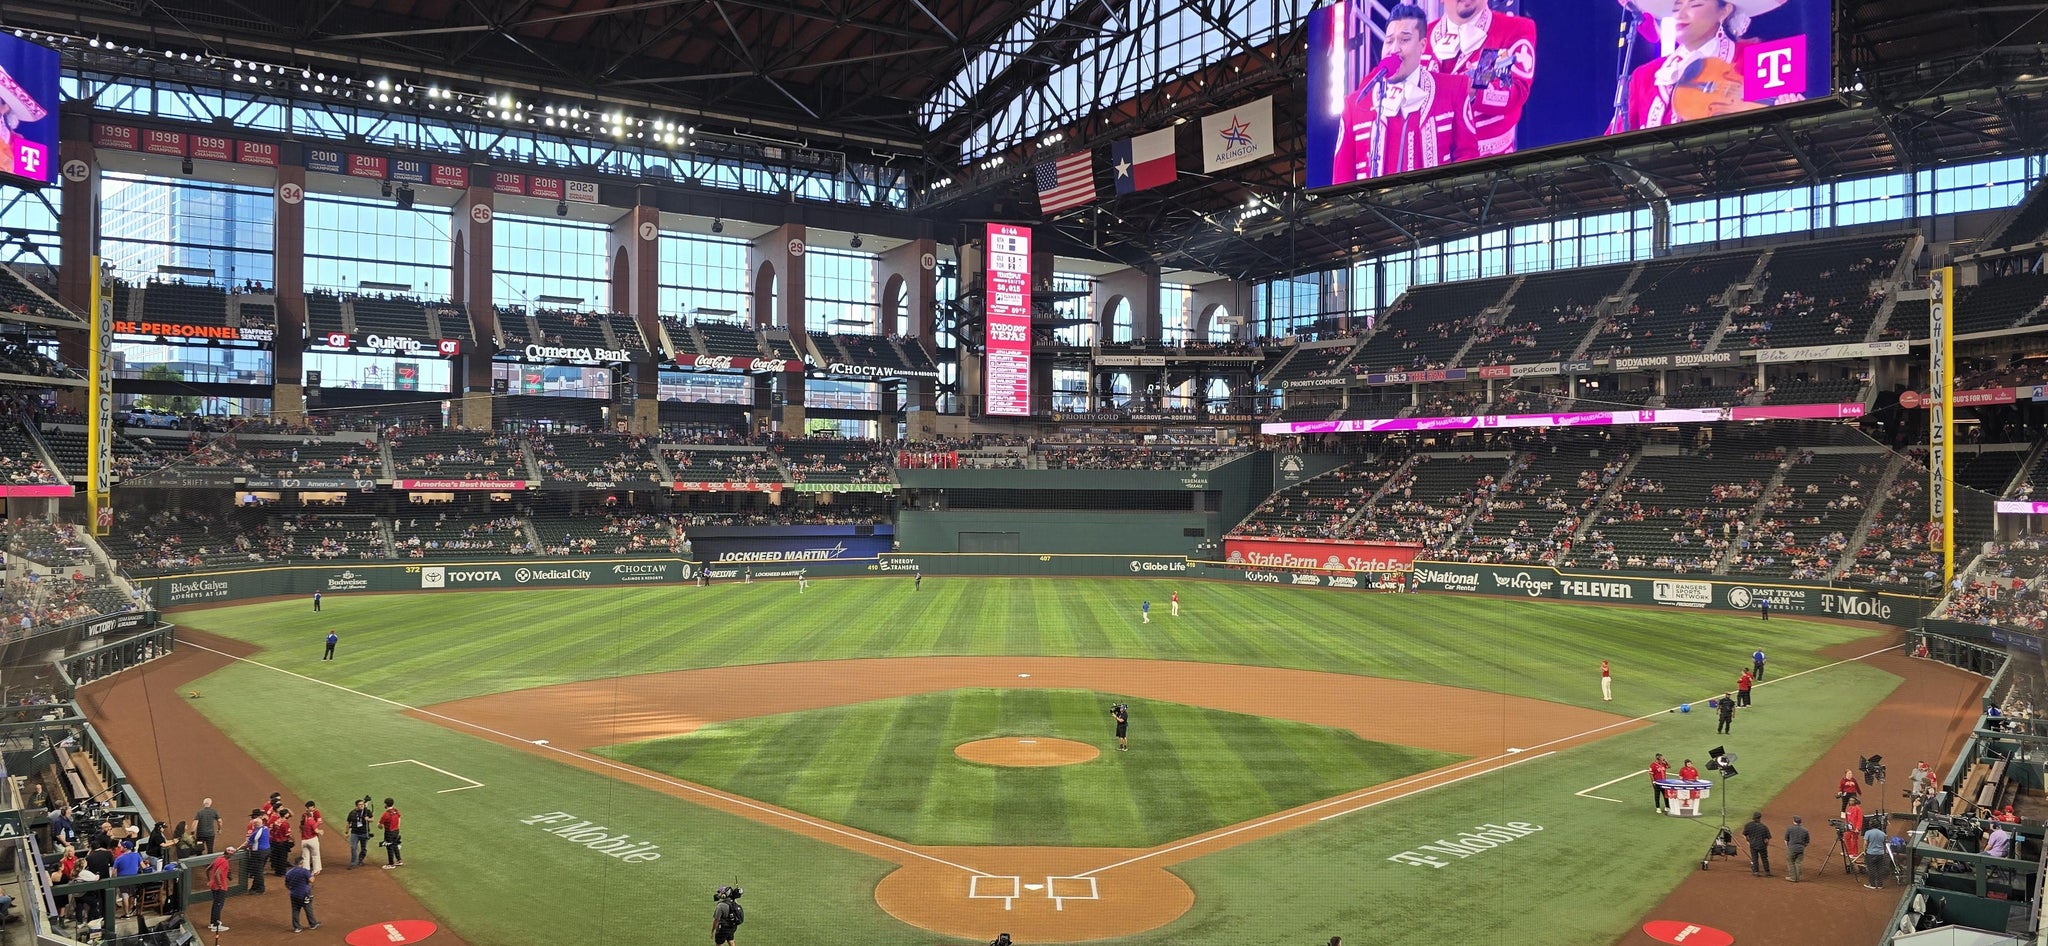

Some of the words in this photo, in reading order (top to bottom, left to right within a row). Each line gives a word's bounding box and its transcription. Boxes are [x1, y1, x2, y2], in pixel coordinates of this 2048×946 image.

[101, 125, 130, 138] 1996
[151, 131, 179, 144] 1998
[197, 136, 225, 149] 1999
[244, 142, 272, 155] 2010
[311, 150, 337, 163] 2010
[1215, 144, 1258, 162] ARLINGTON
[356, 156, 379, 168] 2011
[397, 161, 419, 172] 2011
[67, 163, 85, 178] 42
[438, 166, 461, 177] 2012
[496, 172, 519, 184] 2015
[535, 177, 557, 189] 2016
[283, 187, 301, 200] 34
[570, 182, 594, 193] 2023
[473, 207, 490, 220] 26
[645, 226, 653, 237] 7
[790, 242, 803, 253] 29
[924, 256, 933, 267] 10
[101, 303, 110, 363] ROOT
[141, 322, 240, 339] PERSONNEL
[239, 328, 273, 336] STAFFING
[990, 323, 1012, 331] TODO
[240, 333, 273, 342] SERVICES
[329, 335, 347, 346] QT
[990, 330, 1026, 341] TEJAS
[366, 335, 421, 350] QuikTrip
[440, 341, 457, 353] QT
[594, 349, 631, 362] Bank
[1675, 352, 1731, 364] BODYARMOR
[1932, 307, 1942, 399] CHIKIN
[1616, 356, 1669, 367] BODYARMOR
[836, 363, 894, 376] CHOCTAW
[1512, 365, 1558, 375] GoPGL.com
[1569, 363, 1591, 372] PGL
[1290, 380, 1315, 388] PRIORITY
[1315, 378, 1346, 386] COMMERCE
[1384, 373, 1407, 384] 105.3
[1408, 372, 1426, 382] THE
[1426, 371, 1447, 381] FAN
[1970, 394, 1980, 402] FOR
[1981, 393, 1993, 401] YOU
[1061, 413, 1096, 421] PRIORITY
[1097, 413, 1119, 421] GOLD
[99, 397, 109, 489] CHIKIN
[413, 480, 458, 488] America's
[459, 480, 478, 488] Best
[479, 480, 516, 489] Network
[1933, 449, 1942, 514] FARE
[805, 484, 842, 492] LUXOR
[842, 484, 892, 492] STAFFING
[719, 552, 783, 562] LOCKHEED
[784, 550, 830, 561] MARTIN
[619, 564, 667, 574] CHOCTAW
[1142, 561, 1169, 572] Globe
[1169, 561, 1186, 572] Life
[448, 571, 501, 582] TOYOTA
[532, 569, 571, 580] Medical
[571, 569, 592, 581] City
[1245, 571, 1280, 583] Kubota
[1426, 569, 1480, 585] National
[1444, 583, 1456, 591] Car
[1456, 584, 1477, 592] Rental
[1511, 572, 1554, 597] Kroger
[1675, 584, 1708, 592] RANGERS
[1752, 588, 1773, 596] EAST
[1774, 590, 1805, 598] TEXAS
[1768, 597, 1790, 605] A&M
